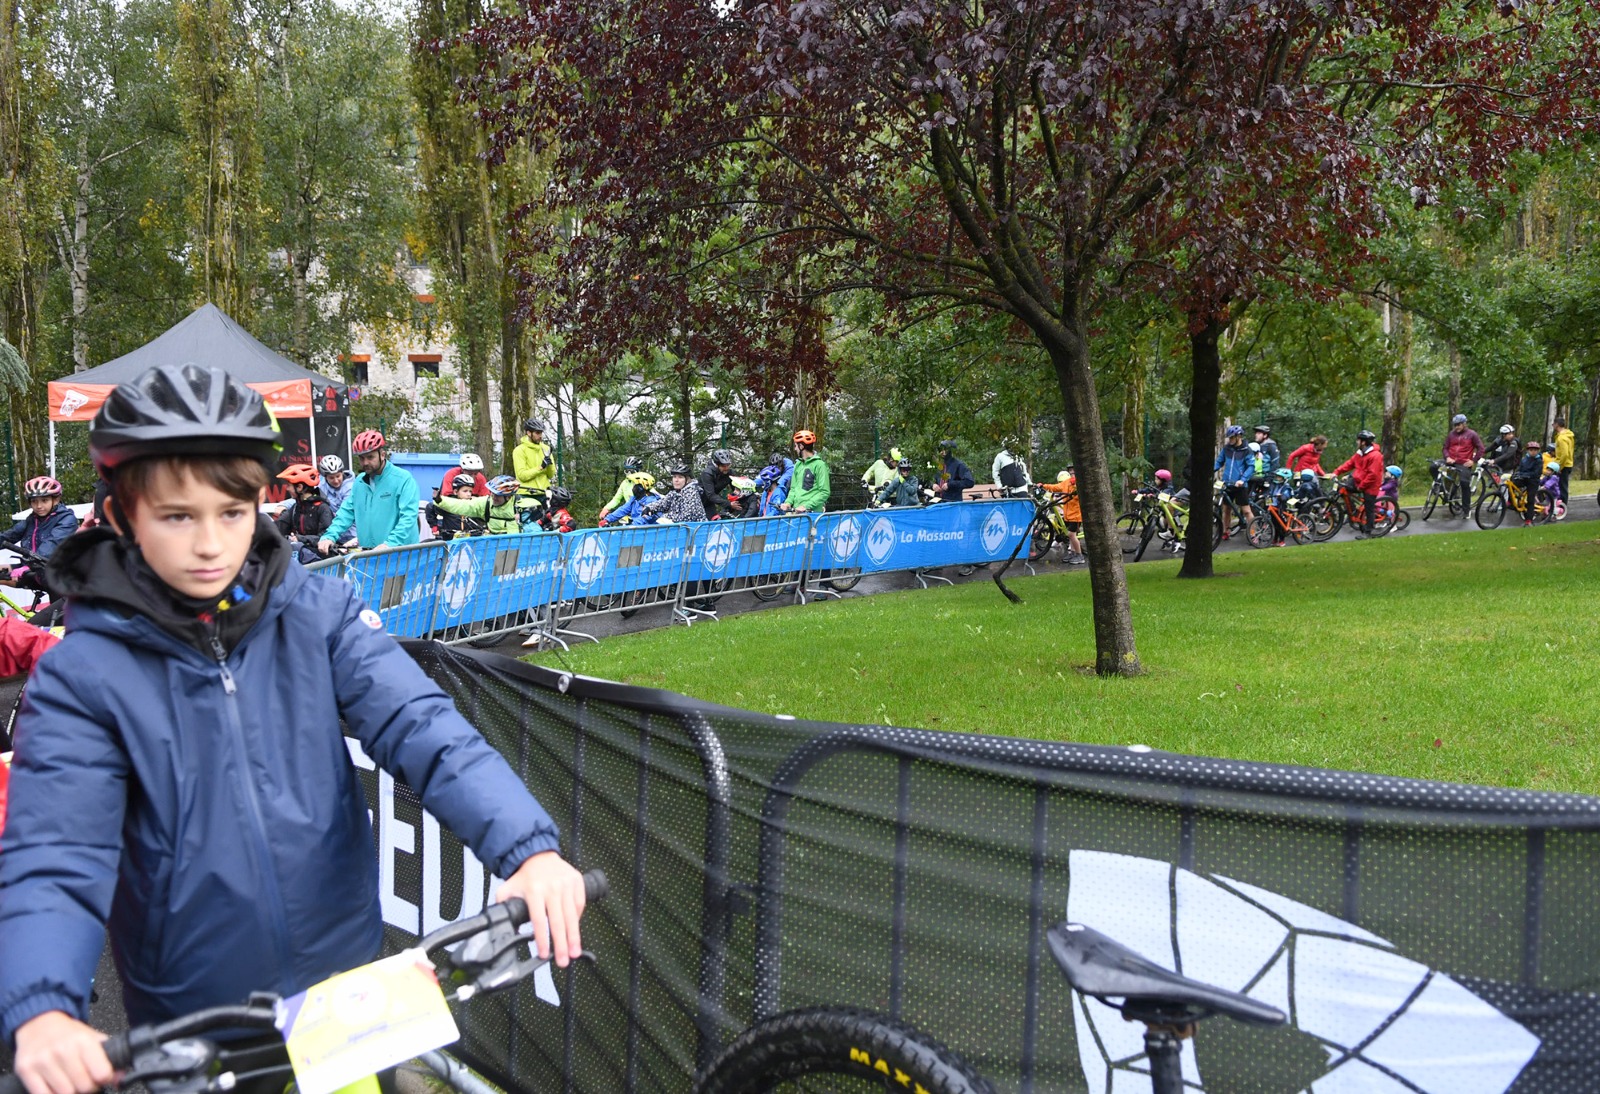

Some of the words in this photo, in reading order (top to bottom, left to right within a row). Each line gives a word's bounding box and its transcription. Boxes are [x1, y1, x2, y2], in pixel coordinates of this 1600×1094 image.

[297, 438, 309, 454] S
[900, 531, 913, 543] La
[916, 530, 964, 542] Massana
[1011, 525, 1023, 536] La
